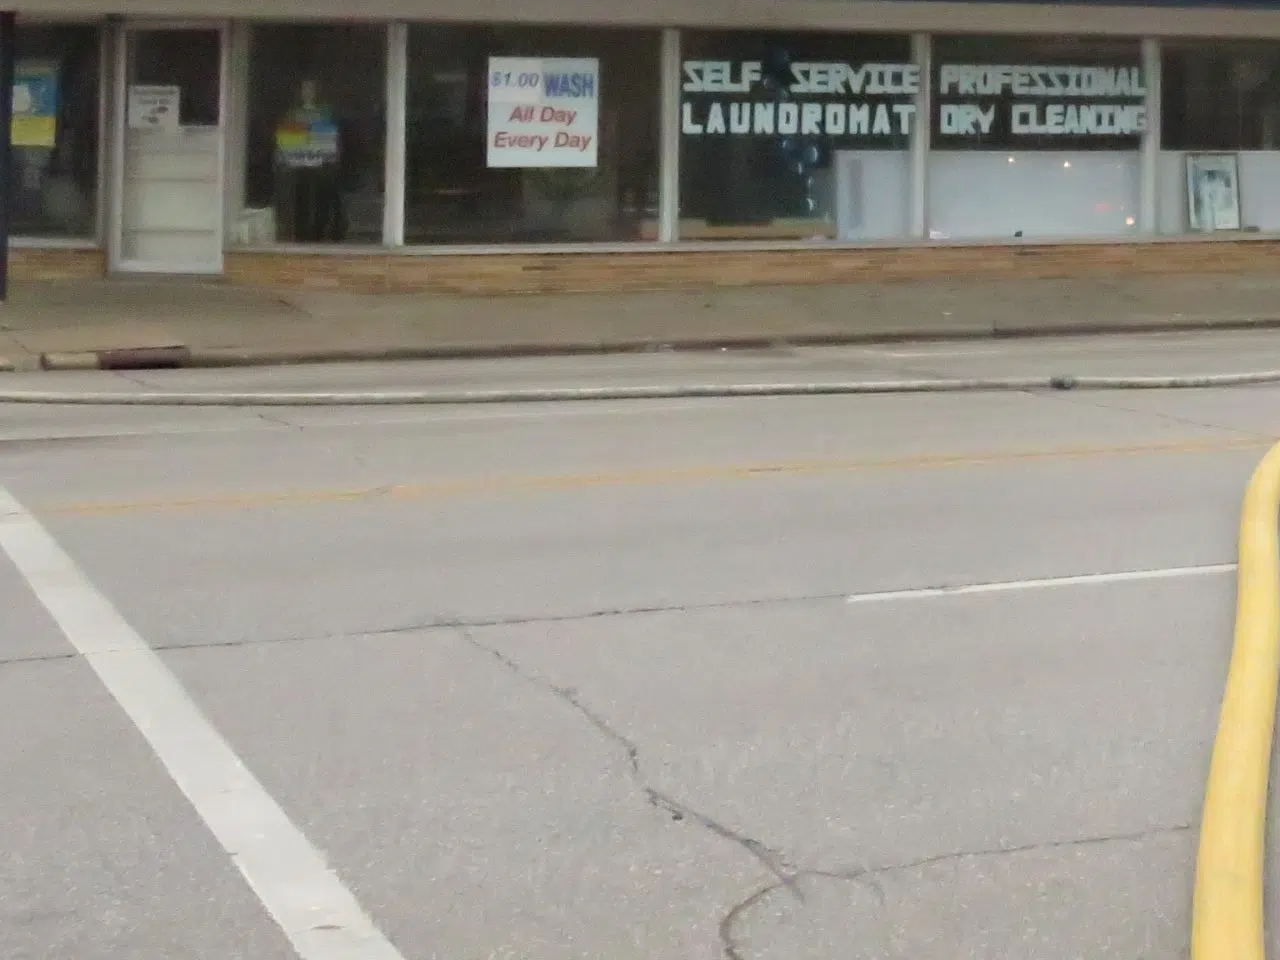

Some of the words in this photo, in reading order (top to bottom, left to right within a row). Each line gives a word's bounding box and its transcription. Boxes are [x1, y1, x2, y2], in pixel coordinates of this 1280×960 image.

[490, 71, 540, 88] $1.00
[543, 71, 595, 98] WASH
[683, 60, 762, 93] SELF
[789, 62, 920, 94] SERVICE
[940, 64, 1148, 97] PROFESSIONAL
[508, 106, 536, 123] All
[540, 106, 578, 127] Day
[681, 102, 917, 135] LAUNDROMAT
[940, 104, 997, 135] DRY
[1010, 104, 1147, 136] CLEANING
[494, 131, 550, 152] Every
[554, 131, 593, 152] Day
